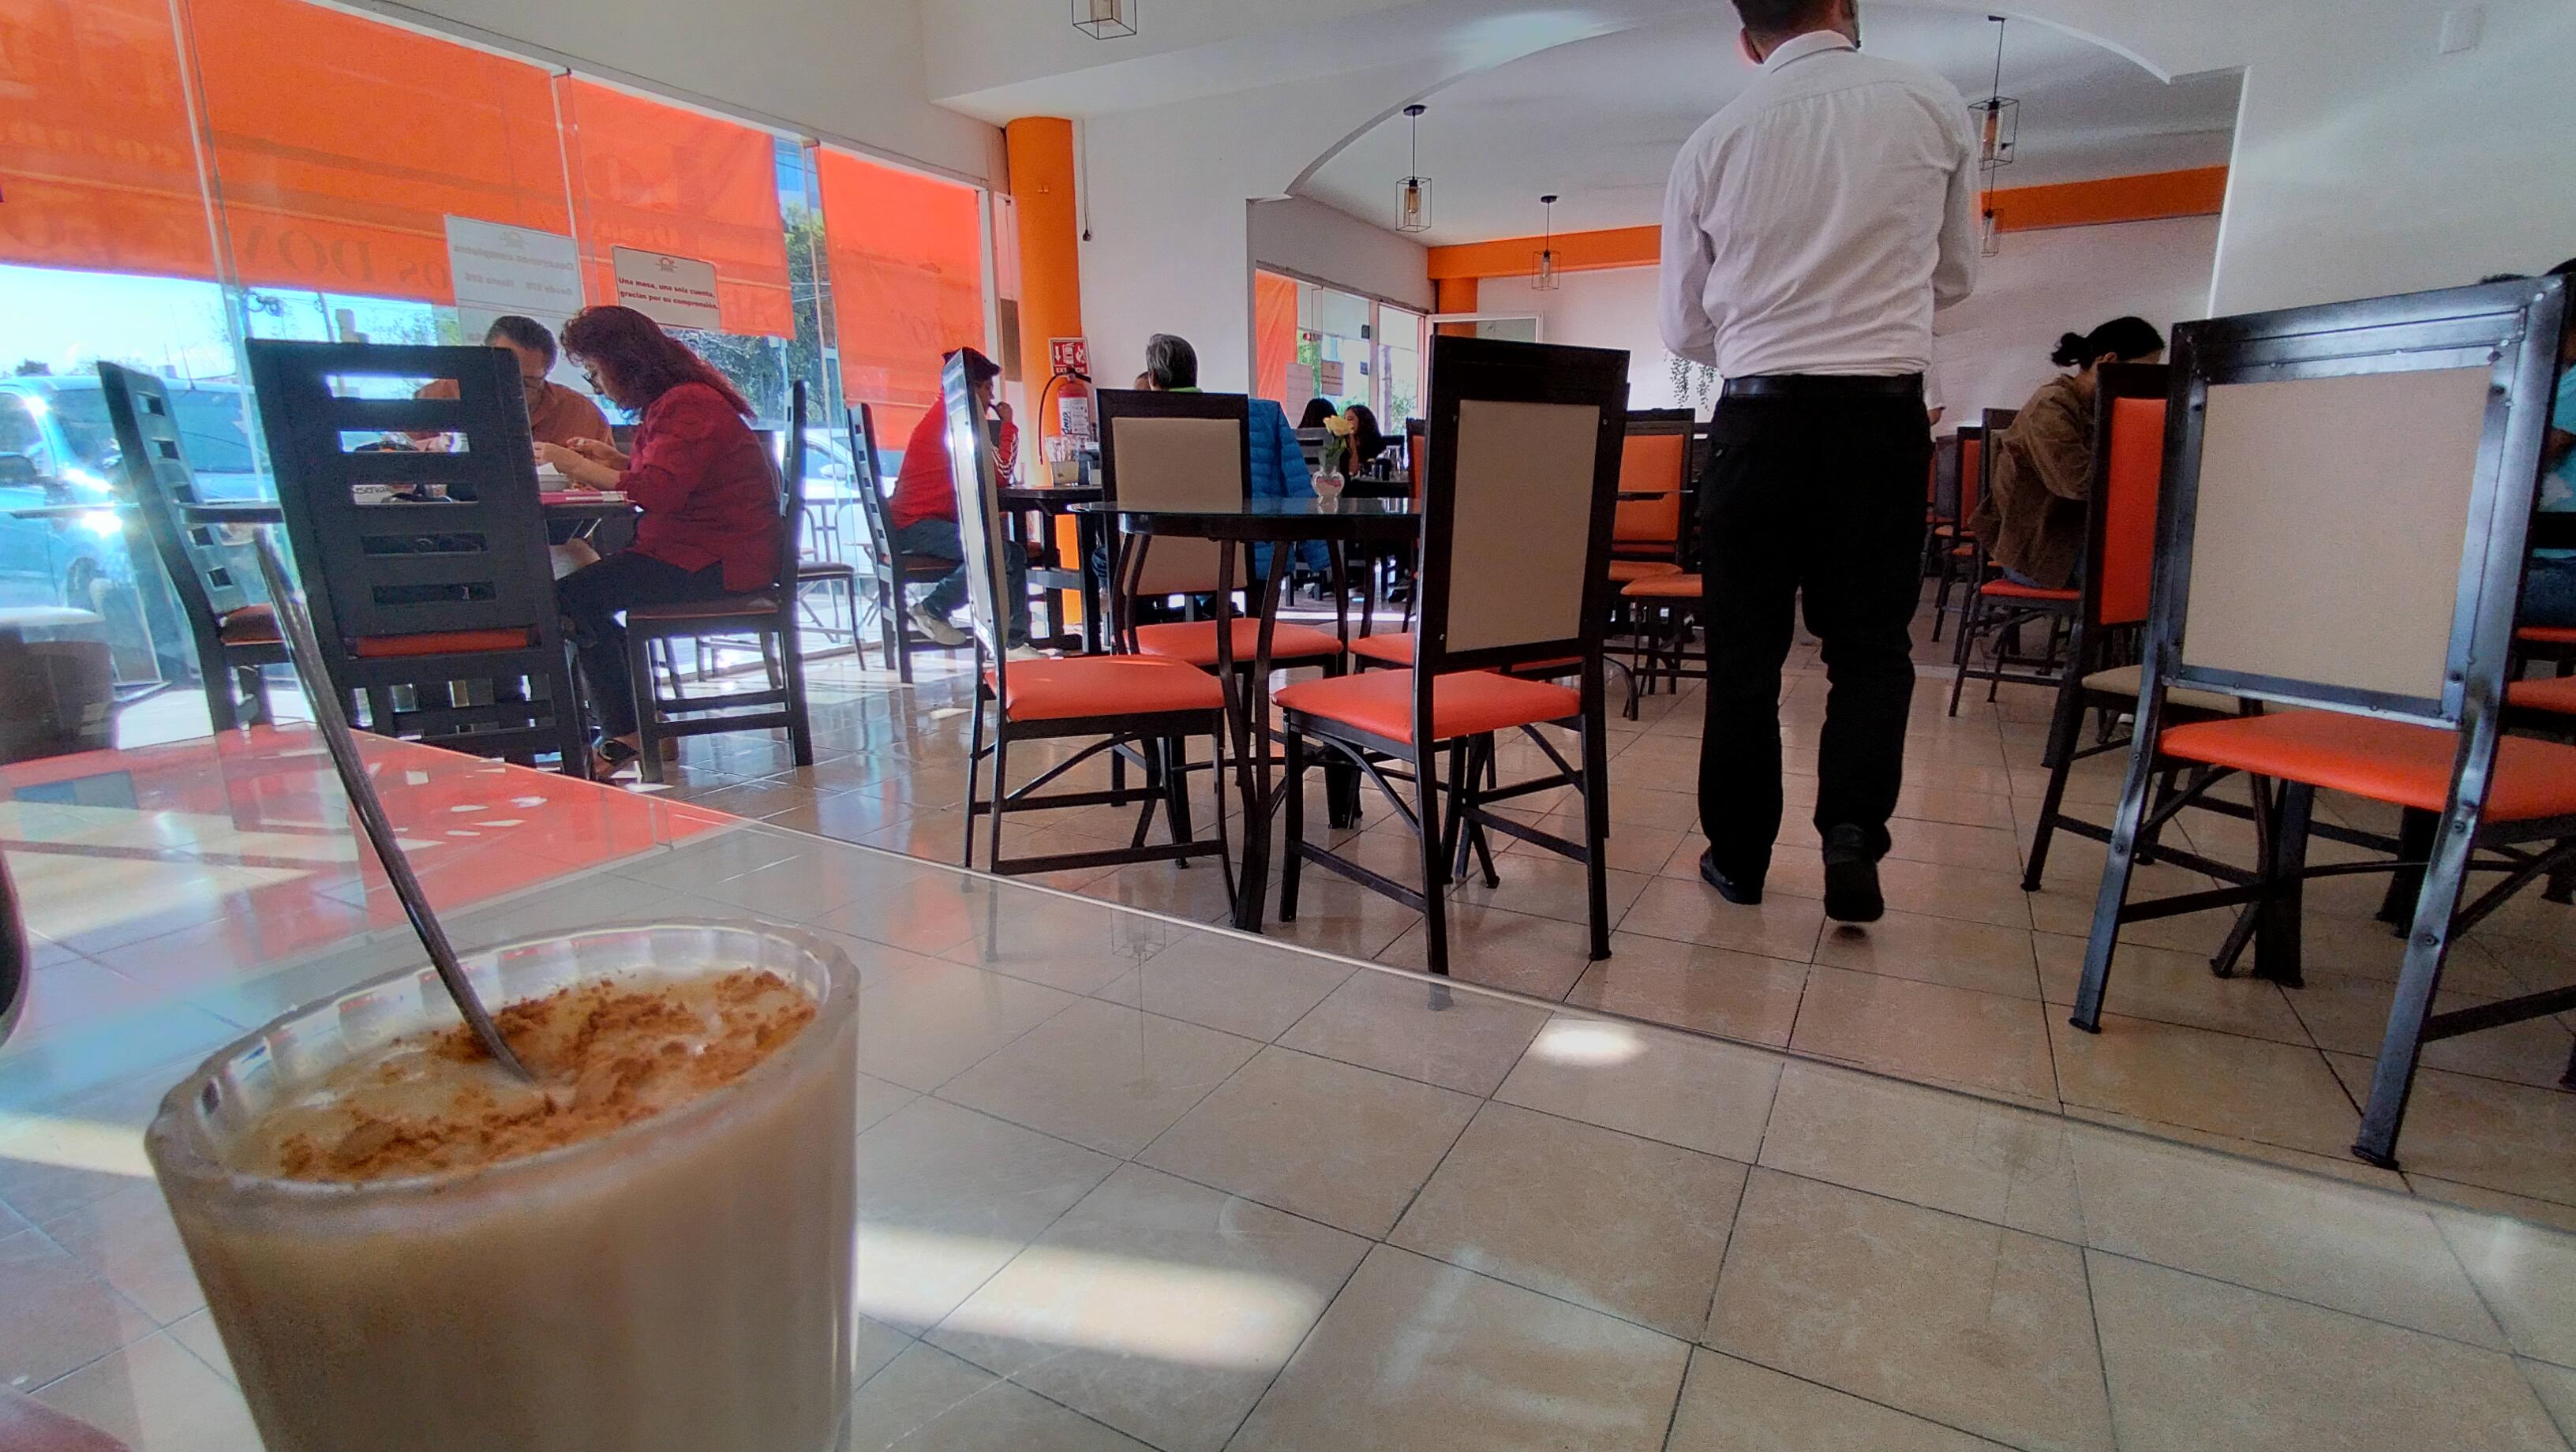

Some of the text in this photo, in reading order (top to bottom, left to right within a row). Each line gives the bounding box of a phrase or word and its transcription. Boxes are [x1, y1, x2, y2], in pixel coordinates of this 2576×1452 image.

[635, 280, 657, 290] mesa,
[690, 290, 716, 298] cuenta,
[620, 290, 647, 300] gracias
[673, 299, 719, 310] comprensión.
